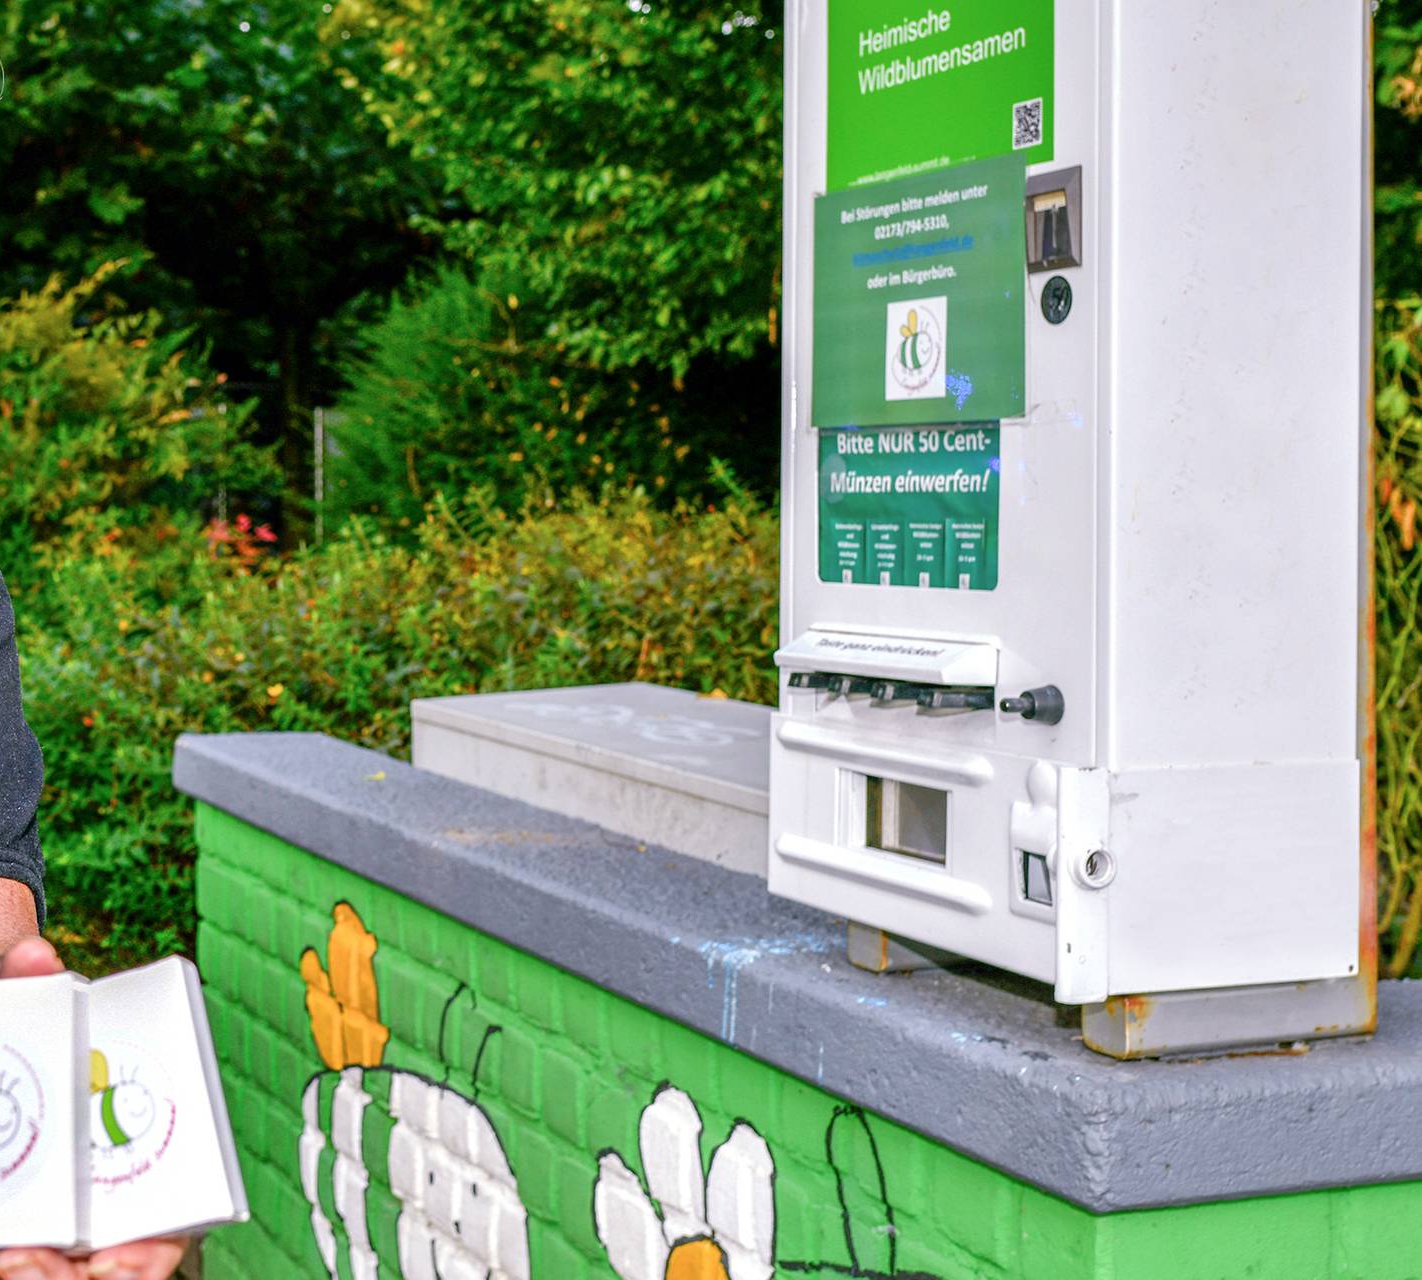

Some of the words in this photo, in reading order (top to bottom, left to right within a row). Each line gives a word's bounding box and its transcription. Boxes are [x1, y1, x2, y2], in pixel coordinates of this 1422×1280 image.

[858, 9, 951, 57] Heimische
[857, 26, 1026, 95] Wildblumensamen
[840, 208, 855, 225] Bei
[855, 201, 901, 219] Störungen
[901, 195, 924, 212] bitte
[924, 190, 960, 207] melden
[961, 185, 989, 201] unter
[867, 273, 888, 290] oder
[889, 270, 901, 286] im
[902, 264, 957, 285] Bürgerbüro.
[837, 432, 874, 455] Bitte
[878, 432, 916, 454] NUR
[919, 431, 940, 453] 50
[943, 430, 991, 451] Cent-
[830, 470, 892, 494] Münzen
[894, 468, 991, 494] einwerfen!
